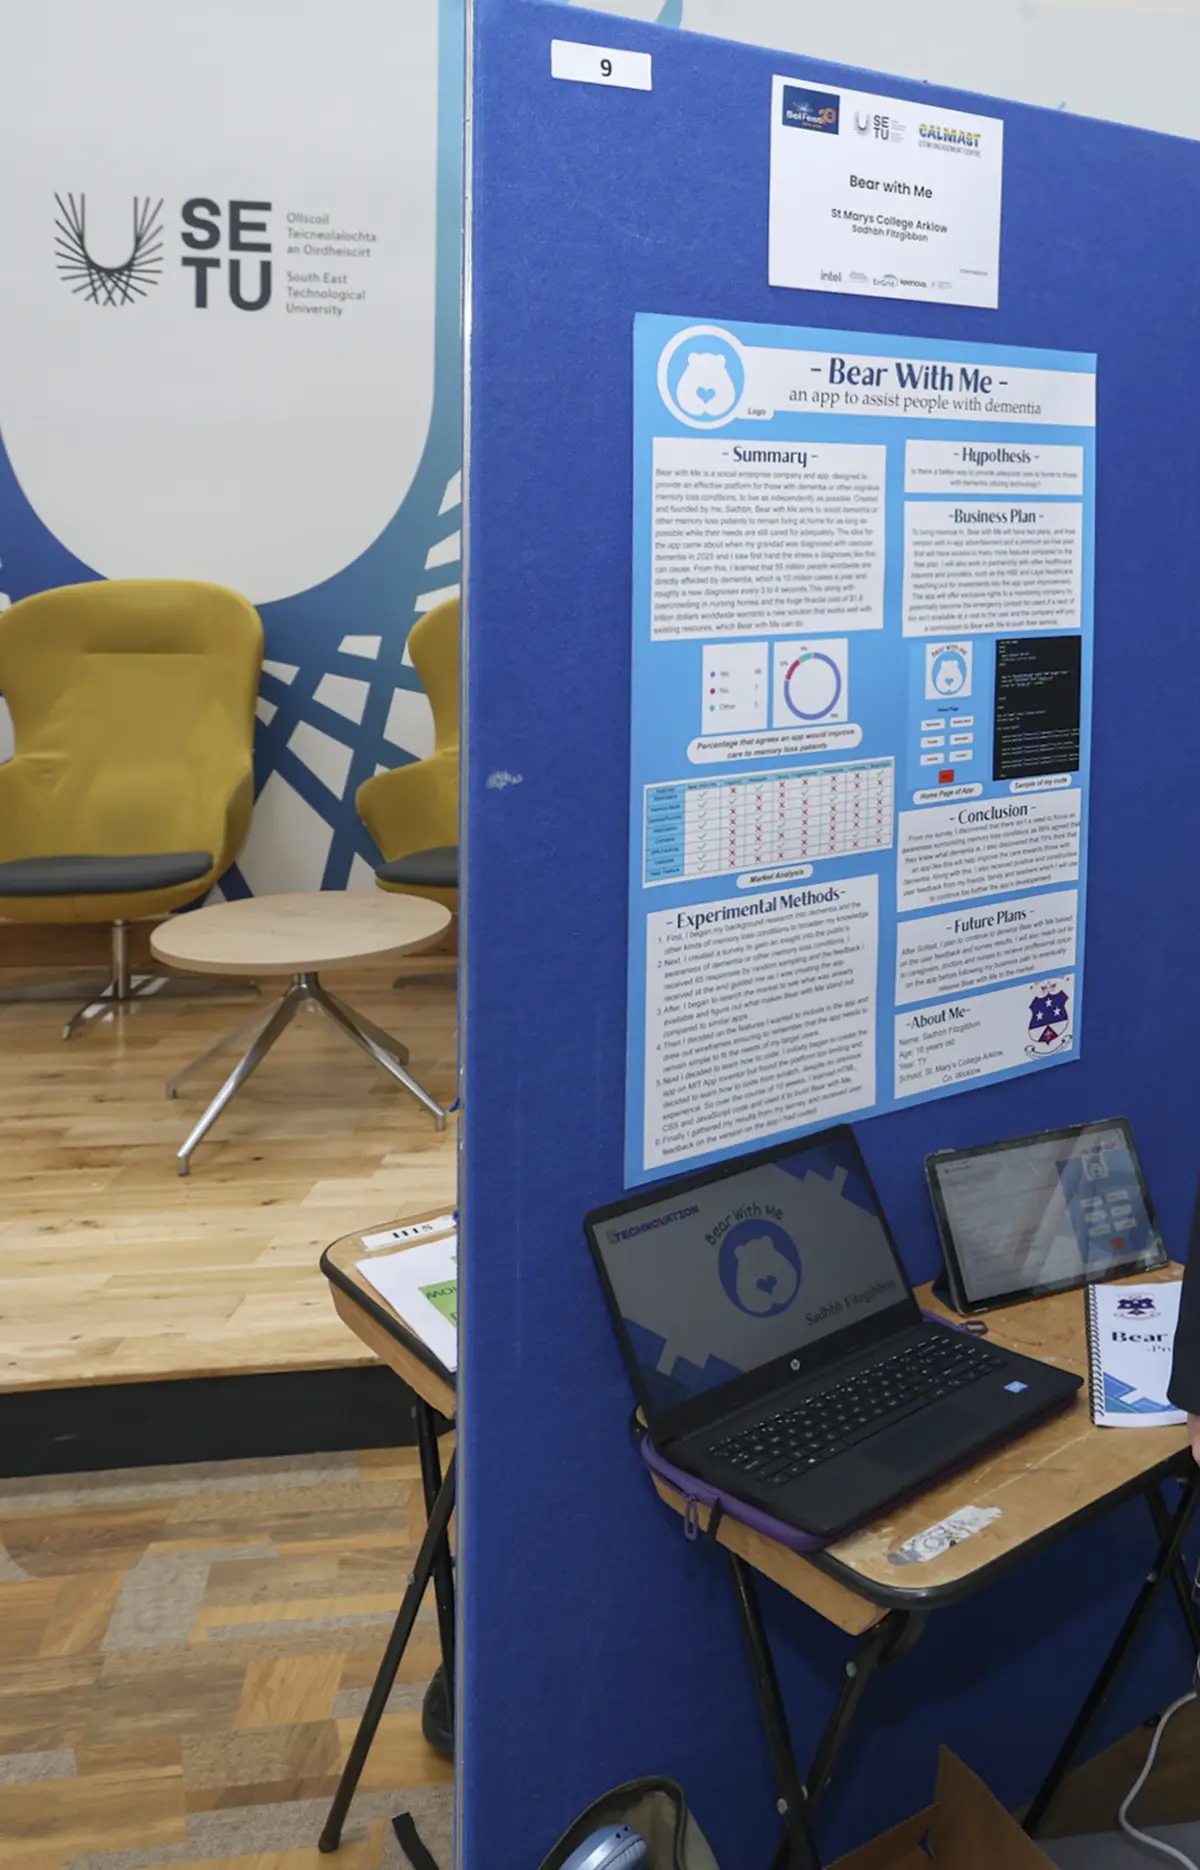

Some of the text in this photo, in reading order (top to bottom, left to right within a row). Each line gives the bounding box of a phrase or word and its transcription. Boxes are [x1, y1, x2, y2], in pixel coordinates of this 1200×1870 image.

[600, 58, 612, 77] 9
[873, 114, 890, 129] SE
[873, 127, 890, 140] TU
[919, 124, 982, 148] CALMAST
[850, 175, 933, 199] Bear with Me
[181, 197, 273, 253] SE
[286, 211, 330, 225] Ollscoil
[831, 208, 948, 233] St Marys College Arklow
[852, 224, 929, 242] Sadhbh Fitzgibbon
[286, 245, 301, 254] an
[181, 256, 273, 312] TU
[286, 271, 348, 285] South East
[820, 269, 842, 283] intel
[287, 286, 366, 302] Technological
[286, 303, 344, 317] University
[829, 358, 992, 394] Bear With Me
[789, 390, 1042, 415] an app to assist people with dementia
[748, 408, 767, 417] Logo
[733, 446, 807, 468] Summary
[962, 447, 1031, 467] Hypothesis
[1010, 509, 1037, 523] Plan
[697, 728, 855, 751] Percentage that agrees an app would improve
[727, 742, 827, 760] care to memory loss patients
[1015, 779, 1037, 790] Sample
[1037, 778, 1044, 787] of
[1045, 778, 1052, 788] my
[920, 786, 974, 801] Home Page of App
[958, 804, 1028, 825] Conclusion
[749, 868, 804, 885] Market Analysis
[677, 897, 777, 930] Experimental
[954, 909, 1027, 933] Future Plans
[926, 1042, 944, 1053] years
[945, 1038, 955, 1048] old
[917, 1057, 928, 1066] TY
[958, 1055, 982, 1067] College
[695, 1108, 731, 1126] JavaScript
[661, 1132, 685, 1146] Finally
[690, 1122, 722, 1139] gathered
[722, 1121, 733, 1131] my
[756, 1109, 774, 1120] from
[613, 1204, 700, 1243] TECHNOVATION
[705, 1202, 784, 1246] Bear With Me
[805, 1278, 897, 1327] Sadhbh Fitzgibbon
[1112, 1332, 1168, 1343] Bear
